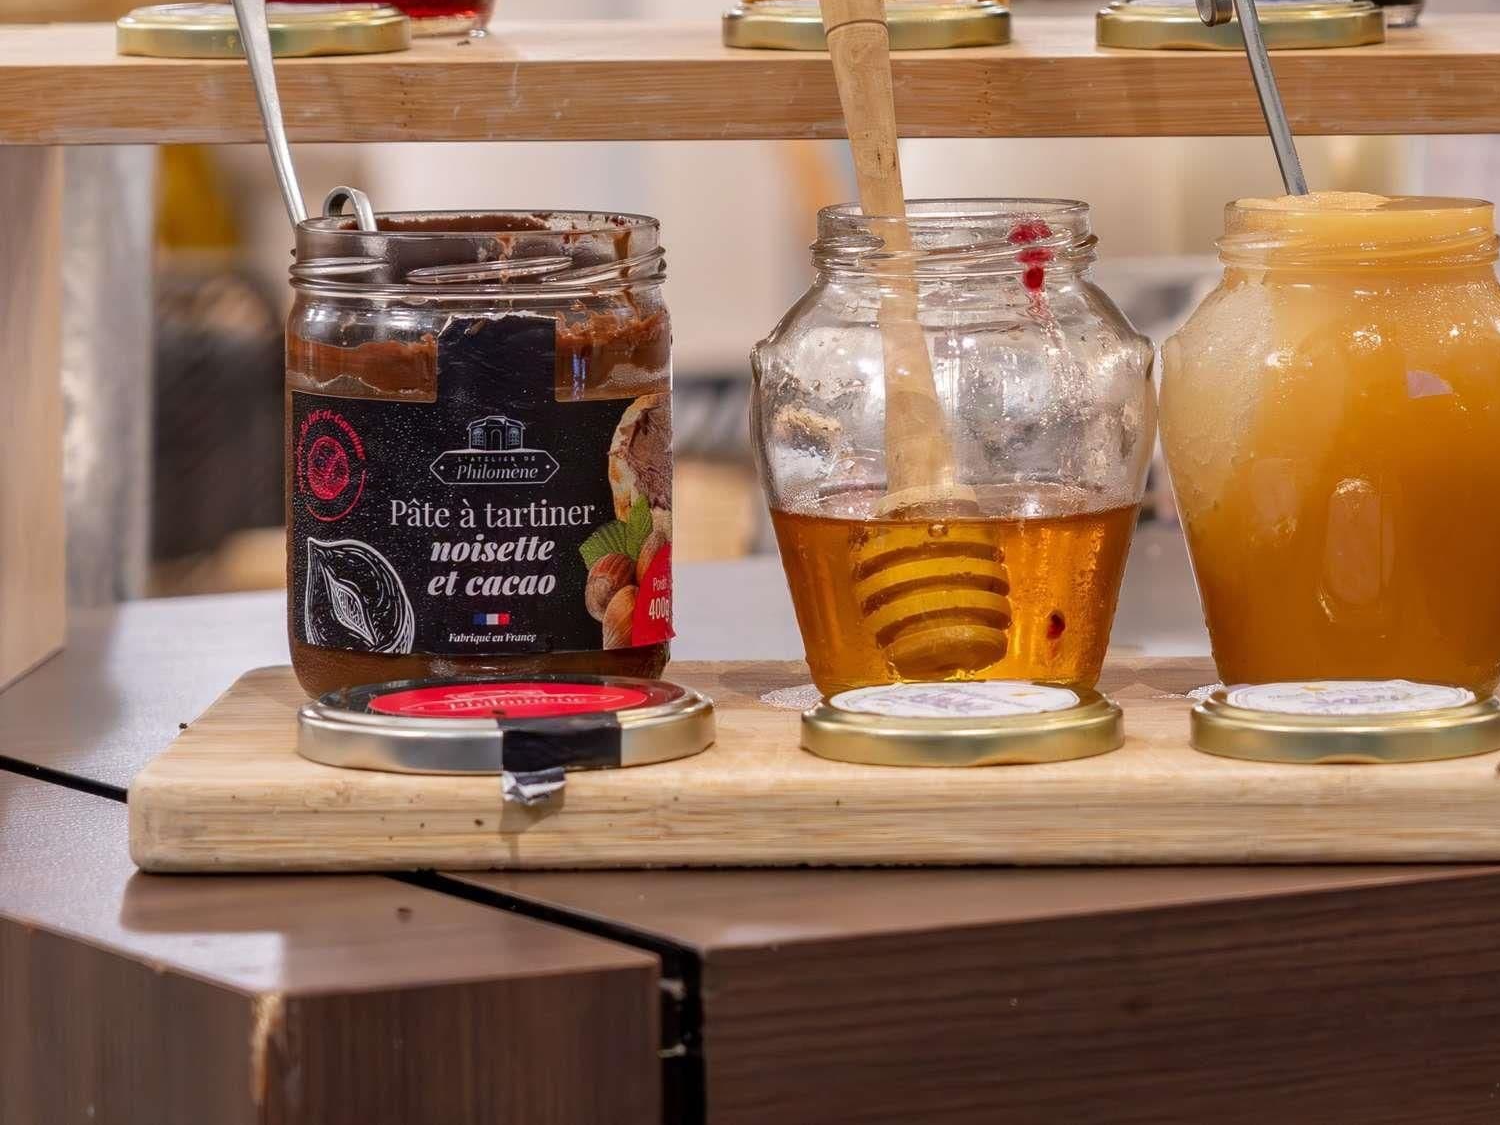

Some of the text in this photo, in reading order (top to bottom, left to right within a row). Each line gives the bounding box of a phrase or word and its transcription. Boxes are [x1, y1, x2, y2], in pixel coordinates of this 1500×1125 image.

[456, 463, 539, 480] Philomène
[390, 498, 596, 528] Pâte à tartiner
[430, 533, 556, 563] noisette
[427, 571, 557, 597] et cacao
[448, 631, 537, 645] Fabriqué en France
